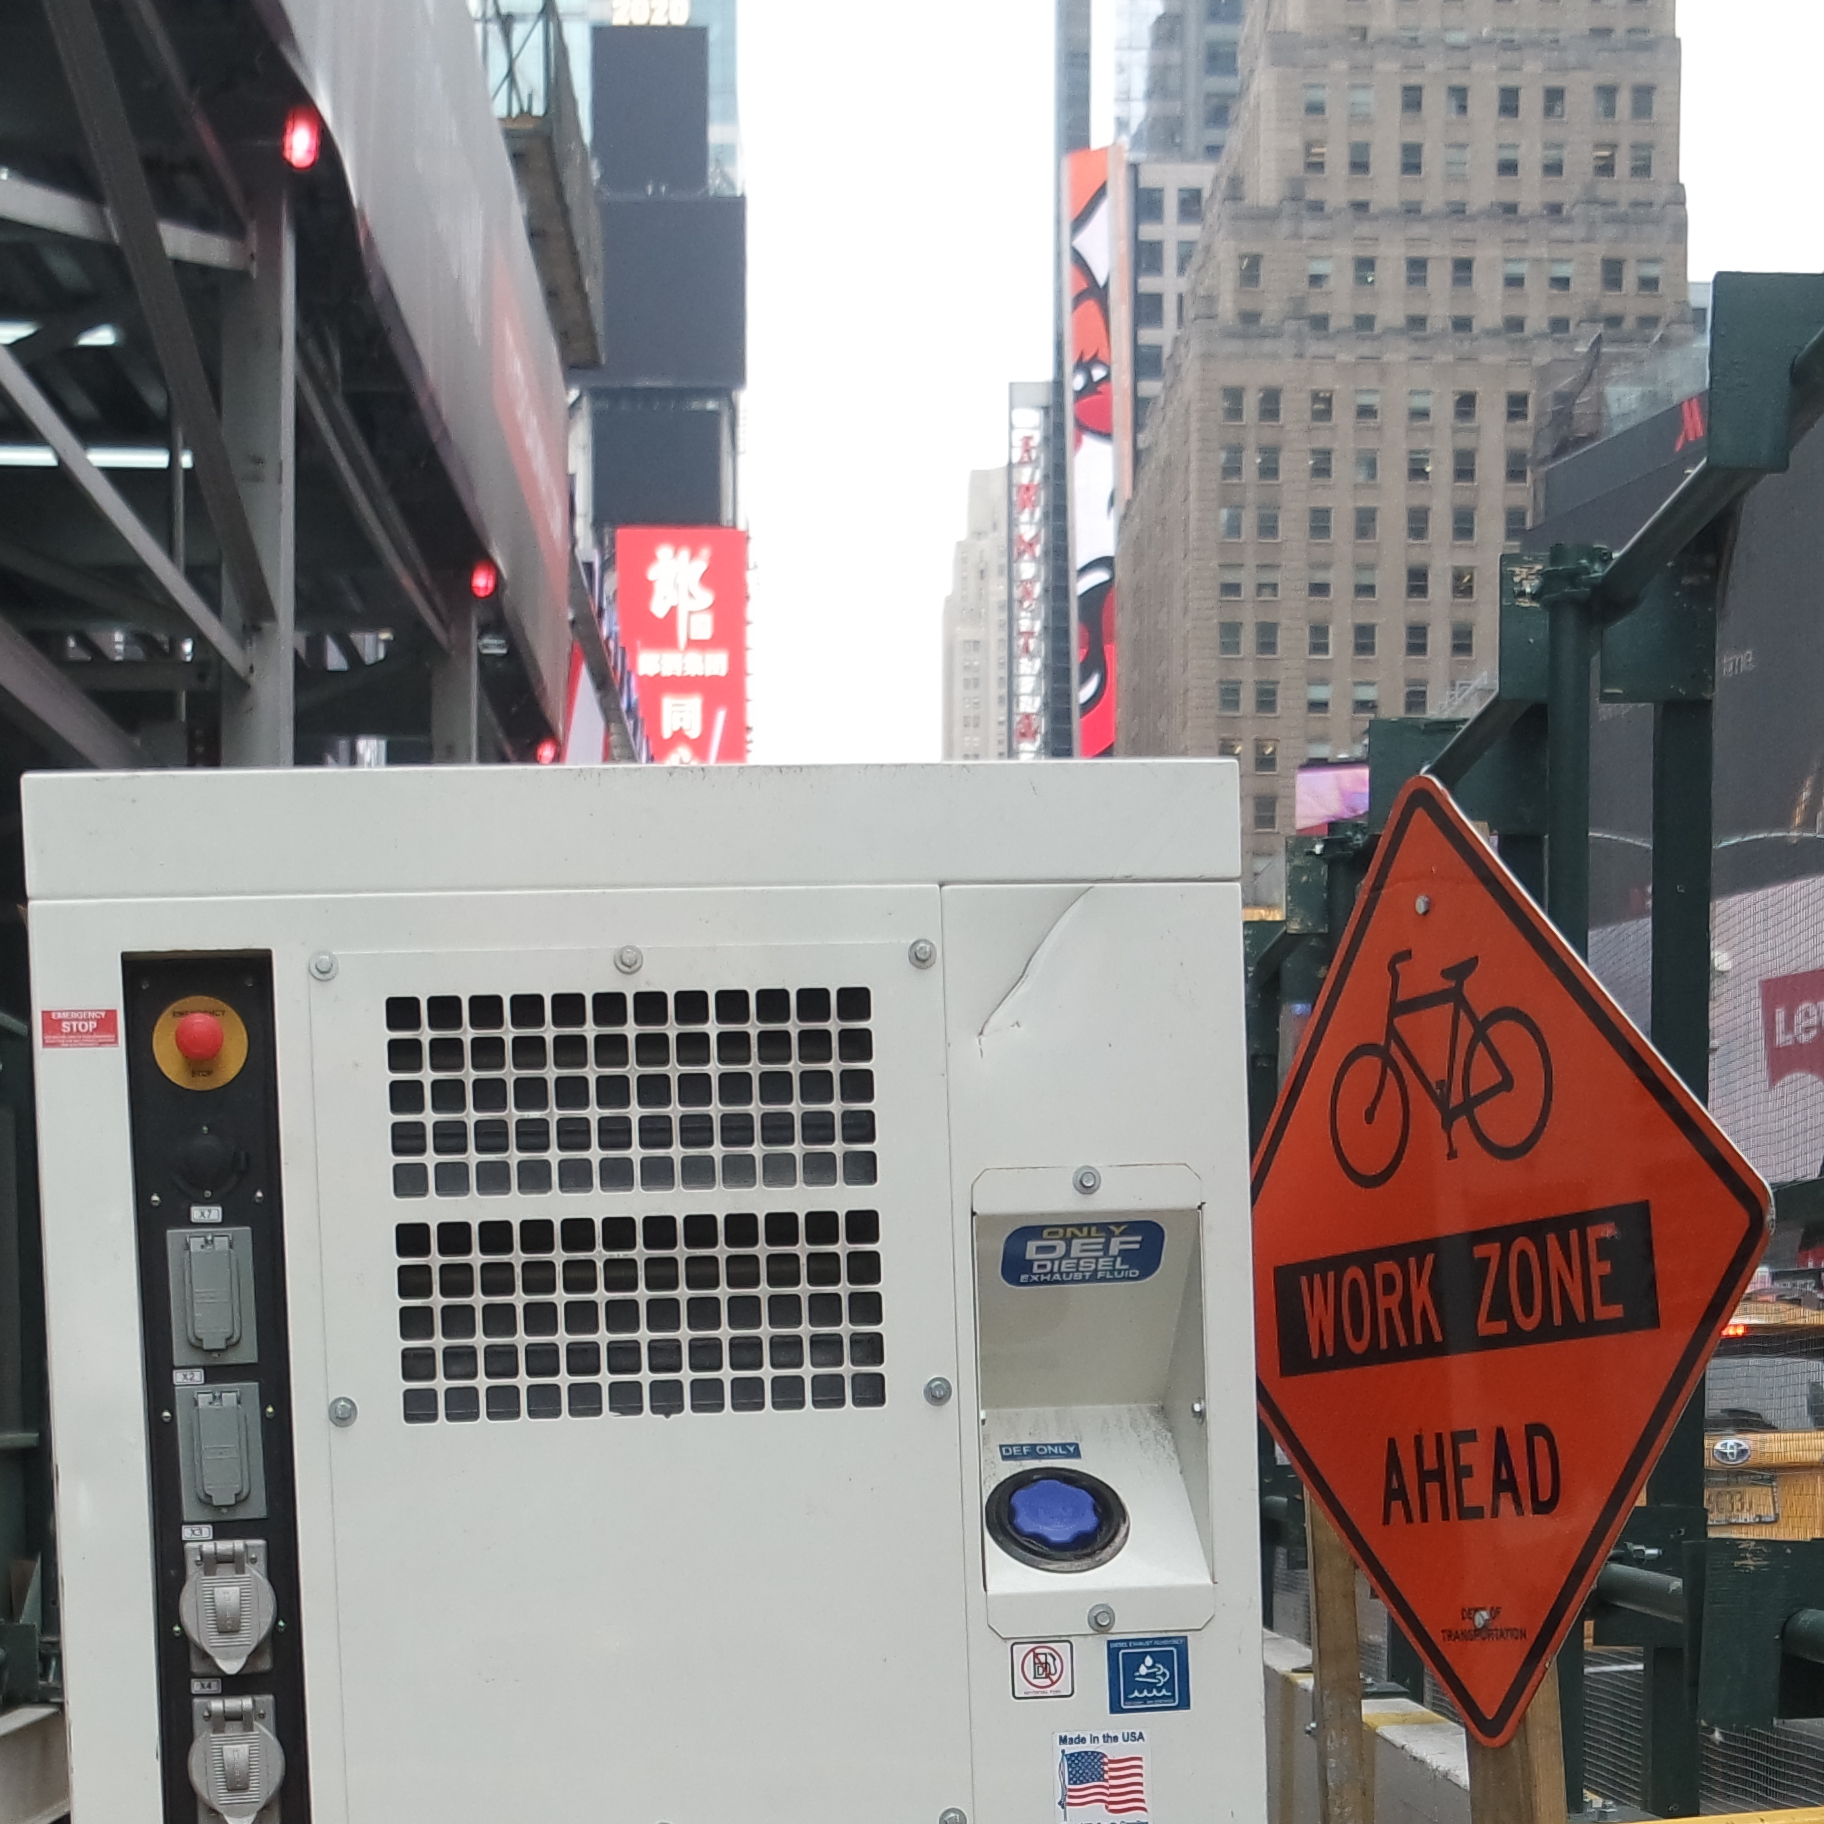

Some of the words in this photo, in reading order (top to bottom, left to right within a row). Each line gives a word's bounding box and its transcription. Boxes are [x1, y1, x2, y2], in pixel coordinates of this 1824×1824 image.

[50, 1010, 107, 1020] EMERGENCY
[61, 1020, 98, 1033] STOP
[1042, 1224, 1128, 1239] ONLY
[1025, 1236, 1143, 1260] DEF
[1032, 1256, 1130, 1274] DIESEL
[1019, 1271, 1093, 1283] EXHAUST
[1096, 1269, 1140, 1280] FLUID
[1301, 1250, 1443, 1360] WORK
[1474, 1222, 1625, 1339] ZONE
[181, 1372, 196, 1382] X2
[1001, 1445, 1031, 1456] DEF
[1035, 1444, 1077, 1455] ONLY
[1381, 1423, 1561, 1526] AHEAD
[1489, 1605, 1503, 1620] OF
[1058, 1734, 1087, 1746] Made
[1089, 1733, 1100, 1744] in
[1102, 1732, 1119, 1744] the
[1122, 1731, 1146, 1742] USA
